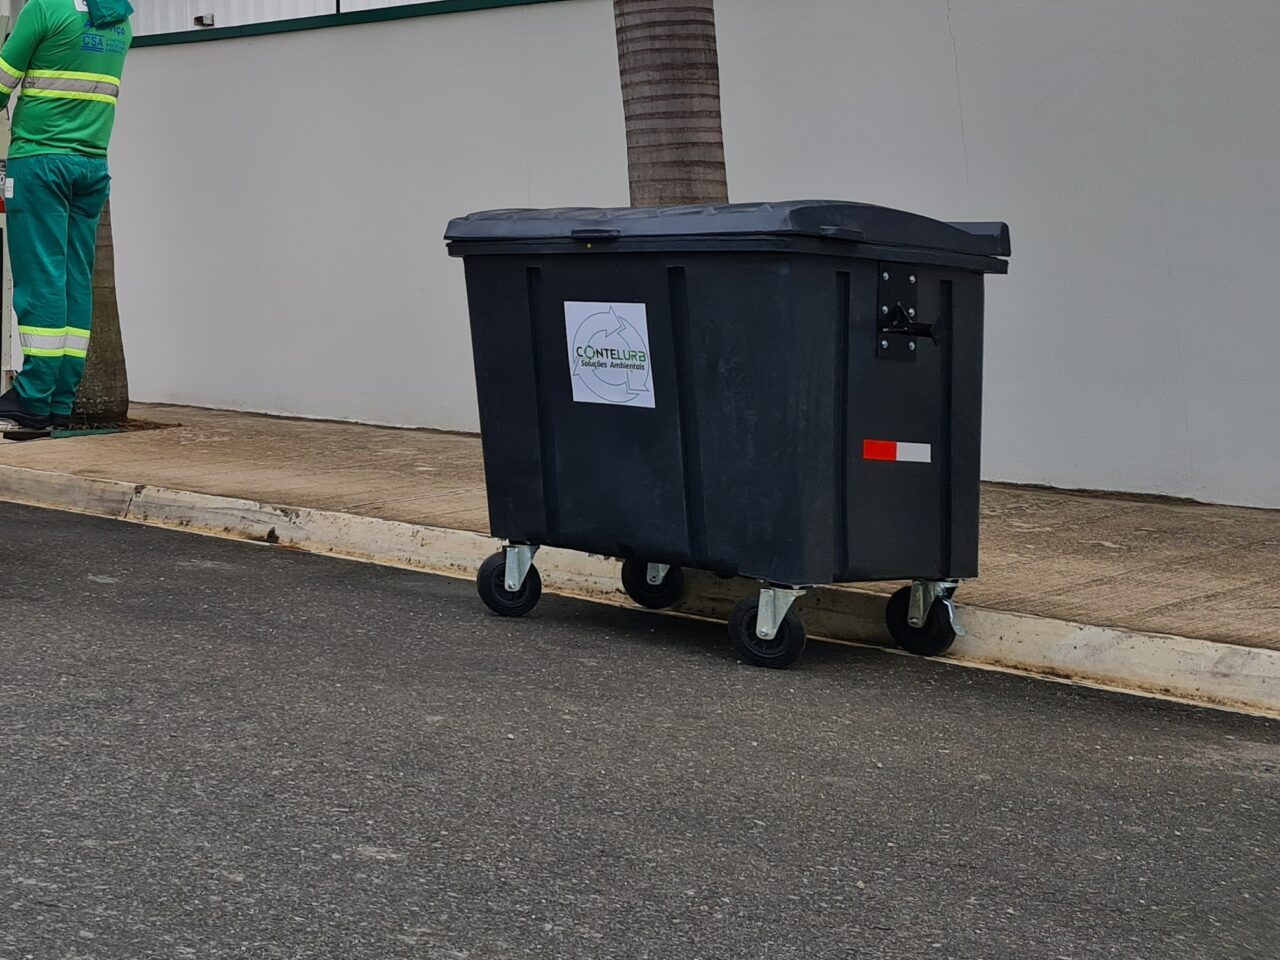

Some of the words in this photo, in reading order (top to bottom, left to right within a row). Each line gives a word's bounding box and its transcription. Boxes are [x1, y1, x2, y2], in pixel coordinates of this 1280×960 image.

[82, 34, 104, 49] CSA
[576, 344, 647, 363] CONTELURB
[581, 360, 608, 369] Soluções
[609, 361, 645, 371] Ambientais
